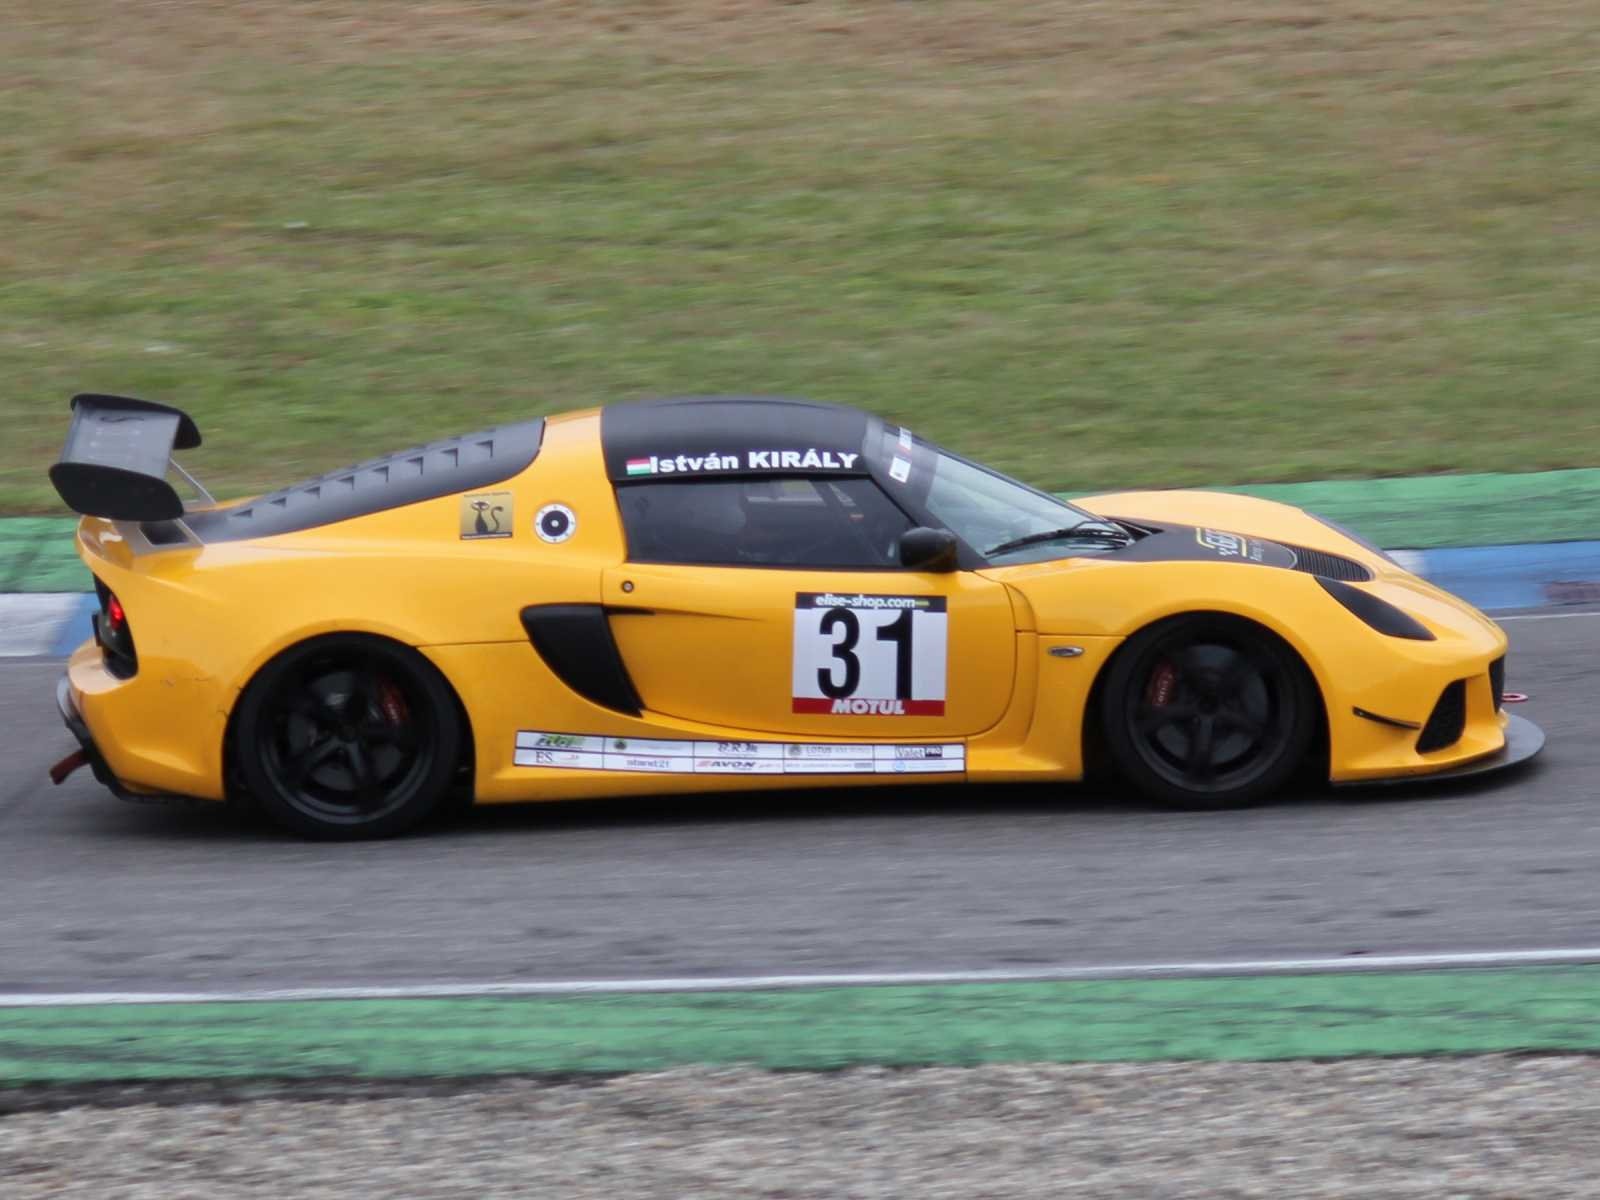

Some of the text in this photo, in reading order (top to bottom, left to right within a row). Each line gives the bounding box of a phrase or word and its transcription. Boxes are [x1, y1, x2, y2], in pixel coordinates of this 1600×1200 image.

[650, 448, 859, 474] István KIRÁLY
[815, 593, 916, 610] elise-shop.com
[817, 608, 913, 701] 31
[831, 699, 905, 715] MOTUL
[536, 751, 554, 764] ES
[806, 746, 833, 754] LOTUS
[896, 746, 925, 758] Valet
